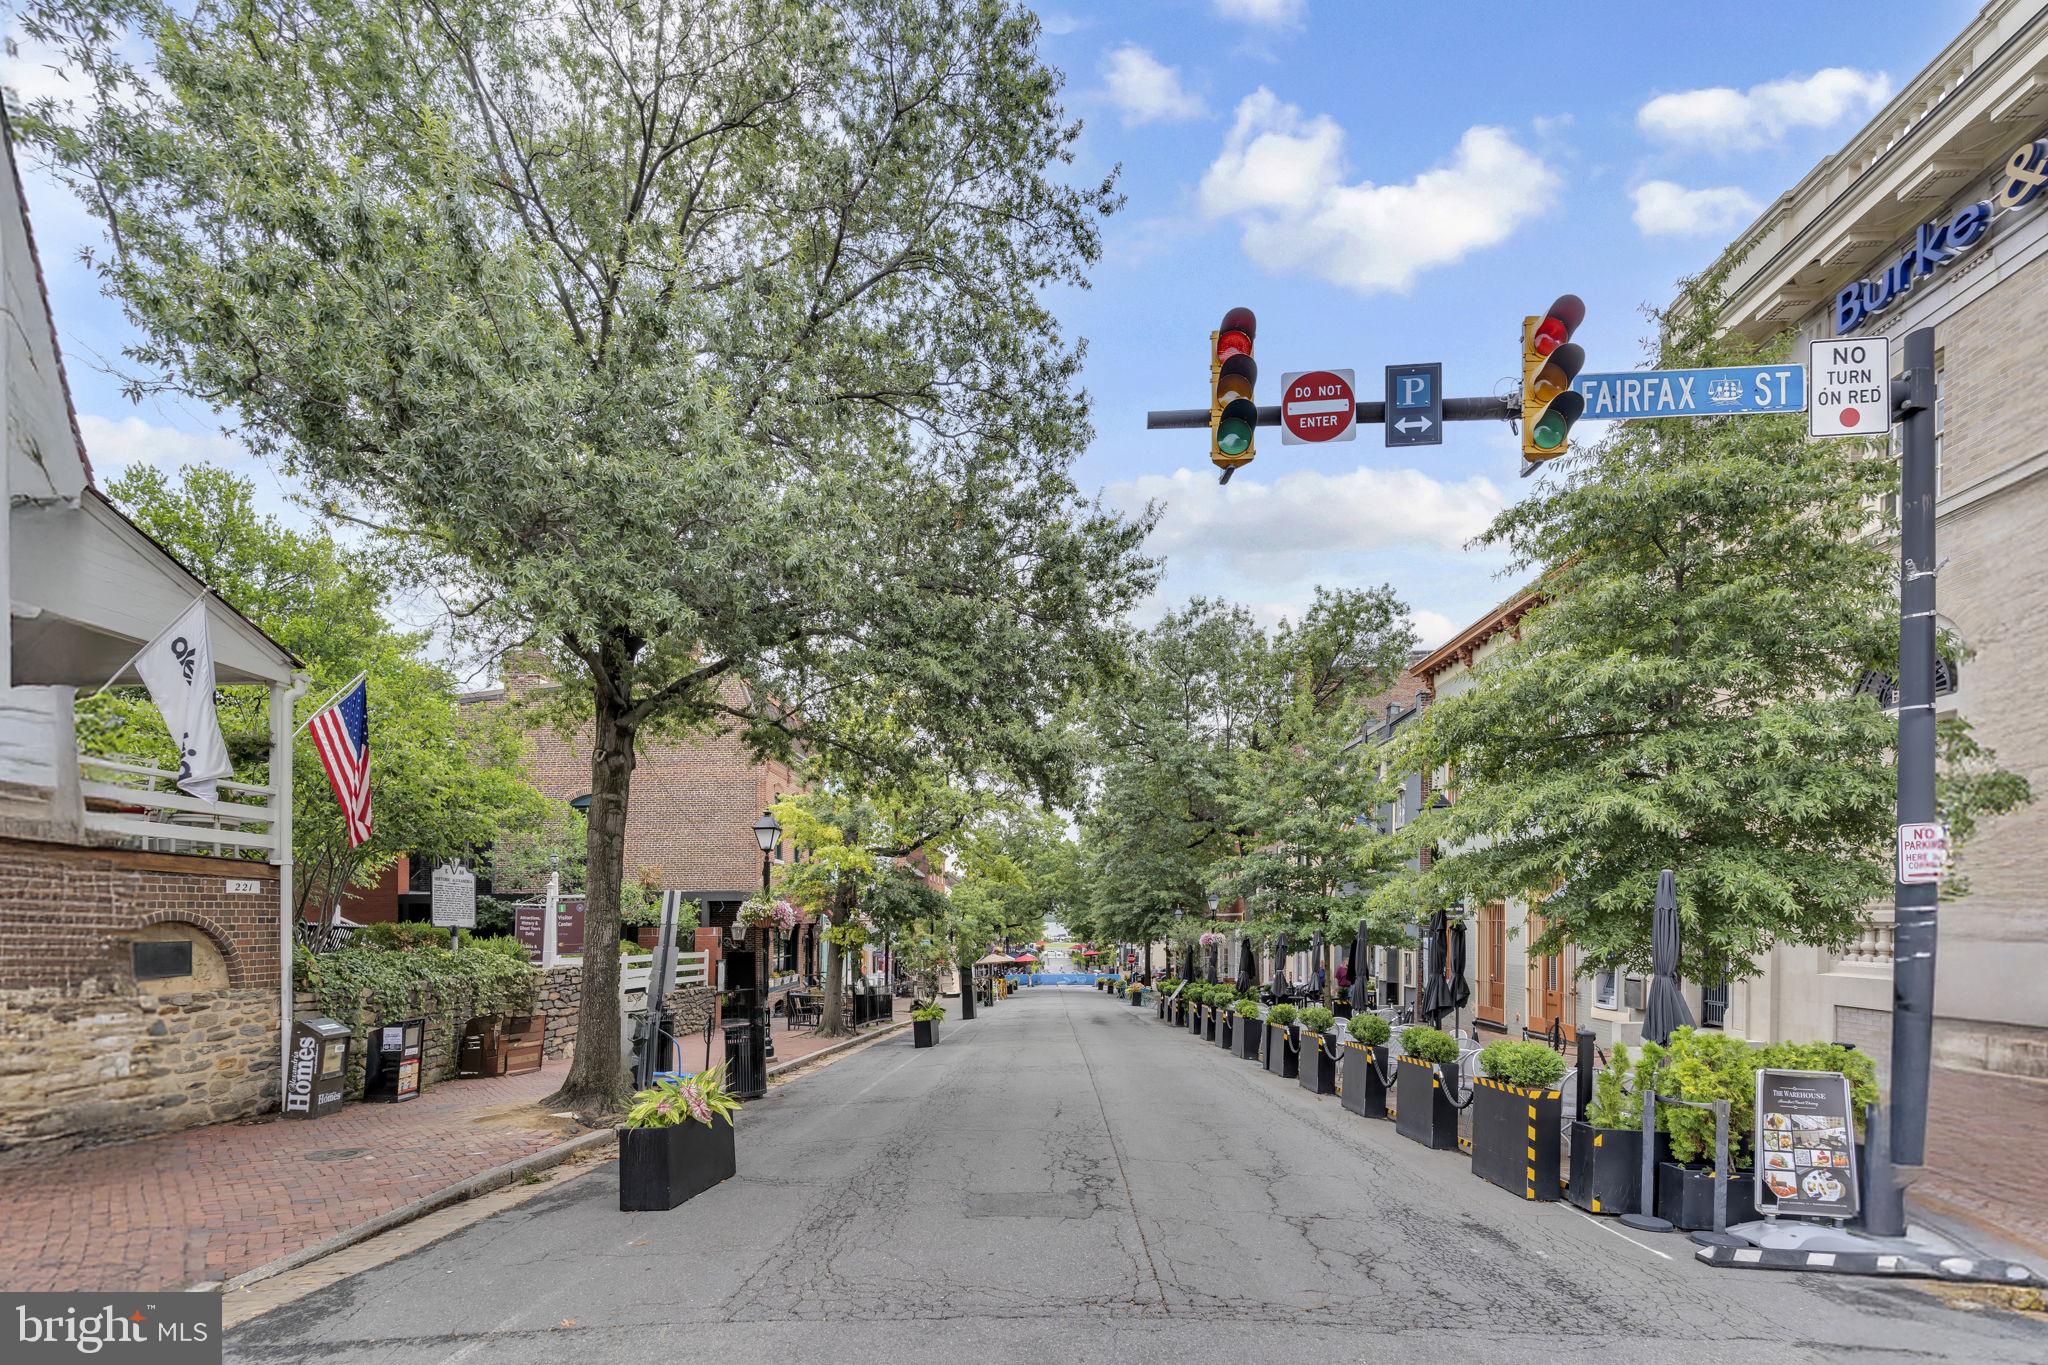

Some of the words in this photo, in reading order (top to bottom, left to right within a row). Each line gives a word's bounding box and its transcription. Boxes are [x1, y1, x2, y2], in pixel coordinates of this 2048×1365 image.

[1836, 199, 1992, 335] Burke
[2000, 142, 2048, 208] &
[1832, 346, 1866, 365] NO
[1827, 369, 1872, 386] TURN
[1295, 386, 1311, 398] DO
[1318, 385, 1343, 397] NOT
[1402, 378, 1425, 406] P
[1582, 374, 1697, 415] FAIRFAX
[1754, 371, 1791, 406] ST
[1818, 388, 1841, 406] ON
[1848, 388, 1881, 405] RED
[1299, 415, 1338, 429] ENTER
[1913, 828, 1935, 840] NO
[234, 882, 253, 892] 221
[287, 1036, 316, 1112] Homes
[288, 1051, 299, 1093] Alexandria
[318, 1091, 341, 1105] Homes
[1773, 1089, 1784, 1097] THE
[1784, 1090, 1826, 1100] WAREHOUSE
